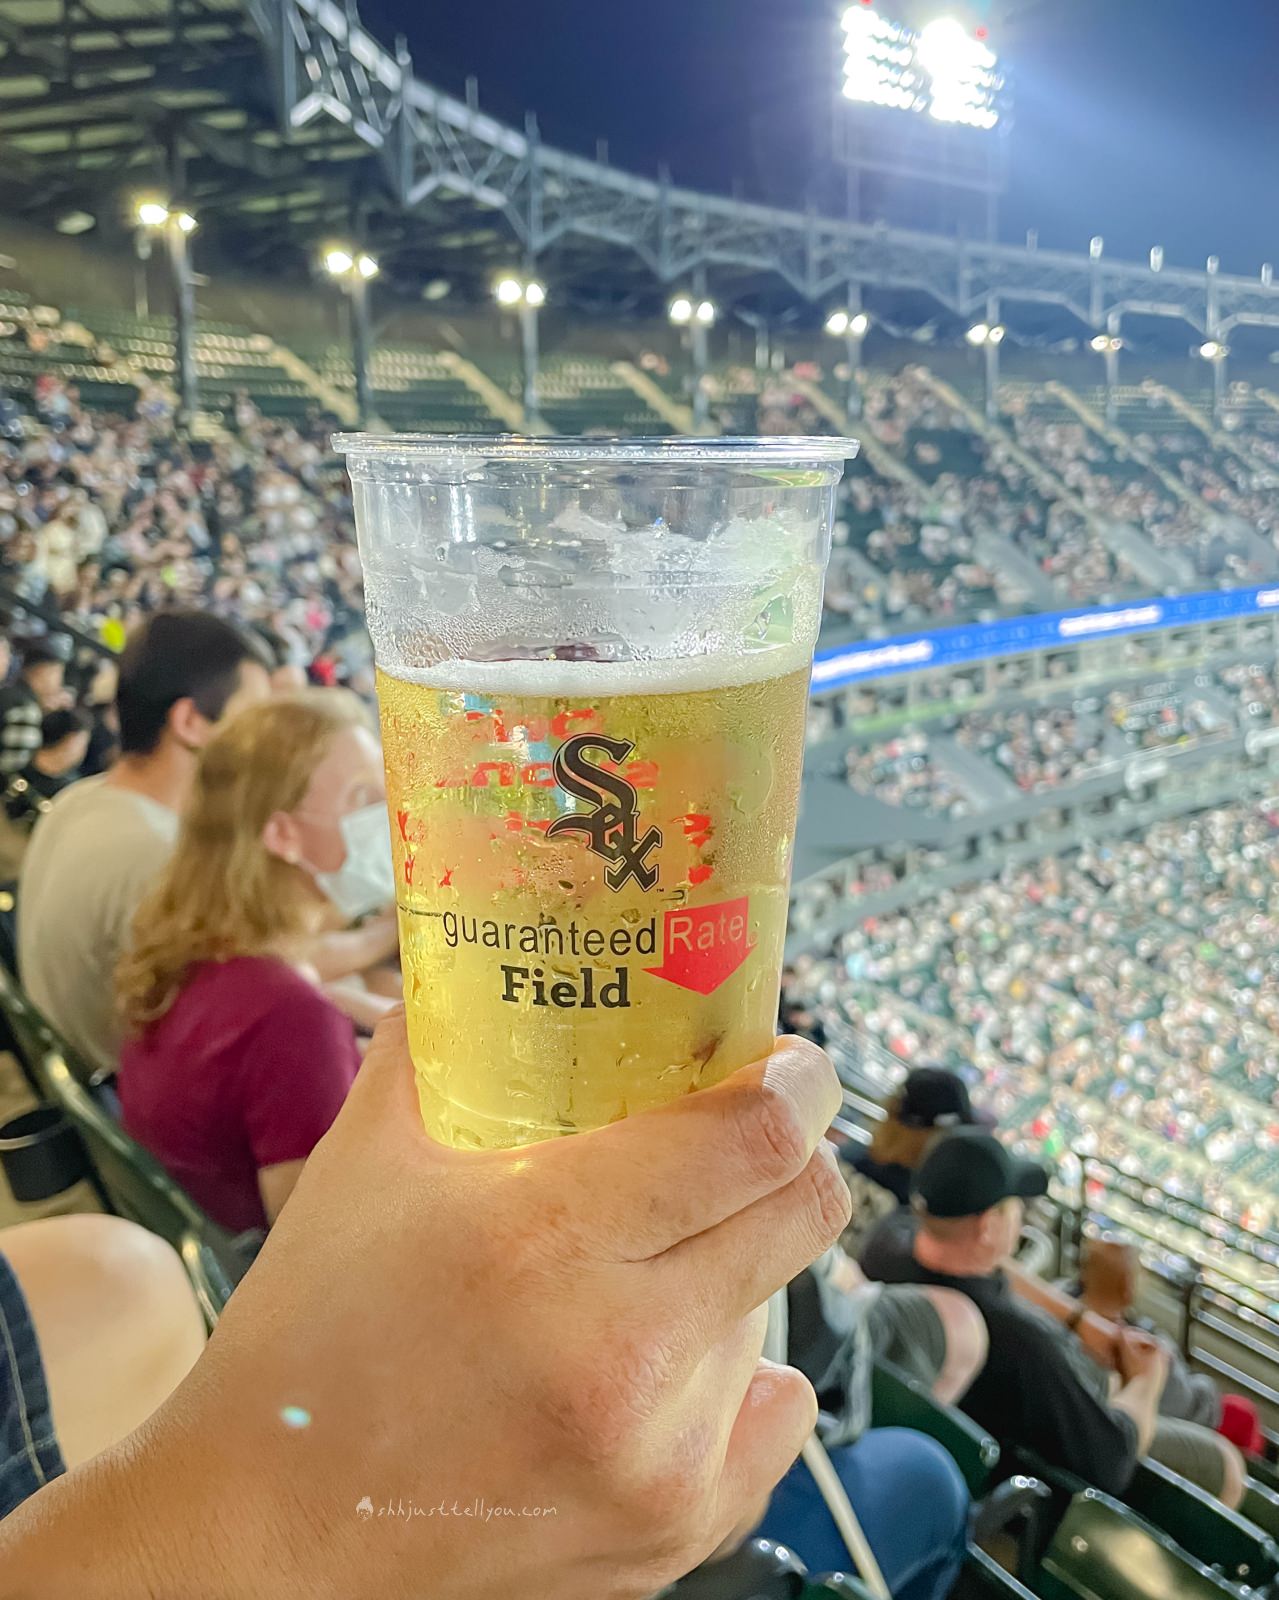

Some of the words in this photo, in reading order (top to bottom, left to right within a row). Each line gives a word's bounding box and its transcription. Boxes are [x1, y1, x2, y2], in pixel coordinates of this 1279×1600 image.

[443, 911, 656, 957] guaranteed
[669, 911, 744, 955] Rate
[500, 964, 630, 1009] Field
